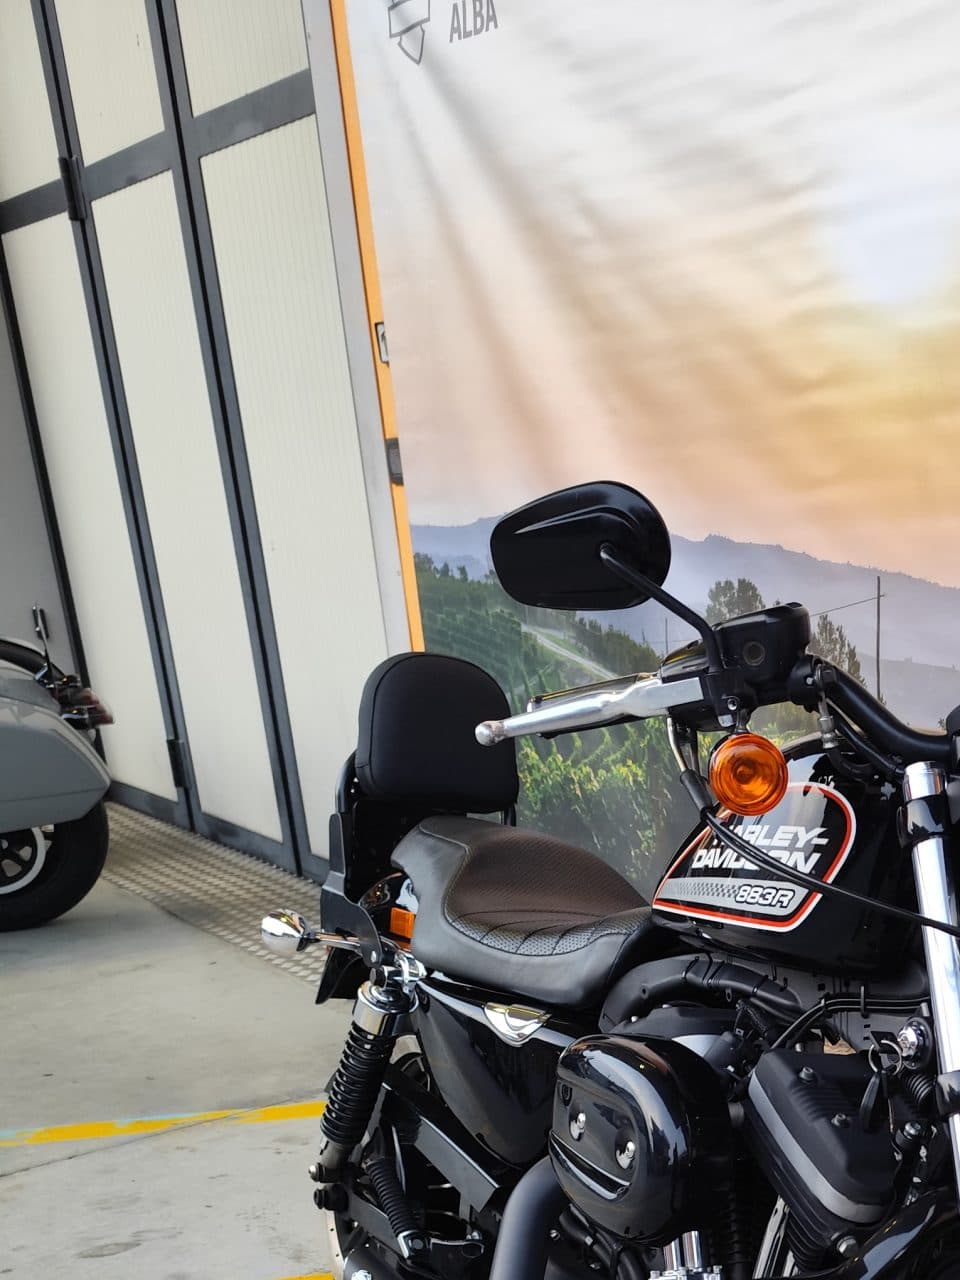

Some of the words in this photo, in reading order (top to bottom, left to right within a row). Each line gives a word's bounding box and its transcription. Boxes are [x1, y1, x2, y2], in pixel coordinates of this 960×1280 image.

[449, 0, 498, 43] ALBA
[713, 825, 829, 848] ARLEY-
[735, 885, 795, 908] 883R
